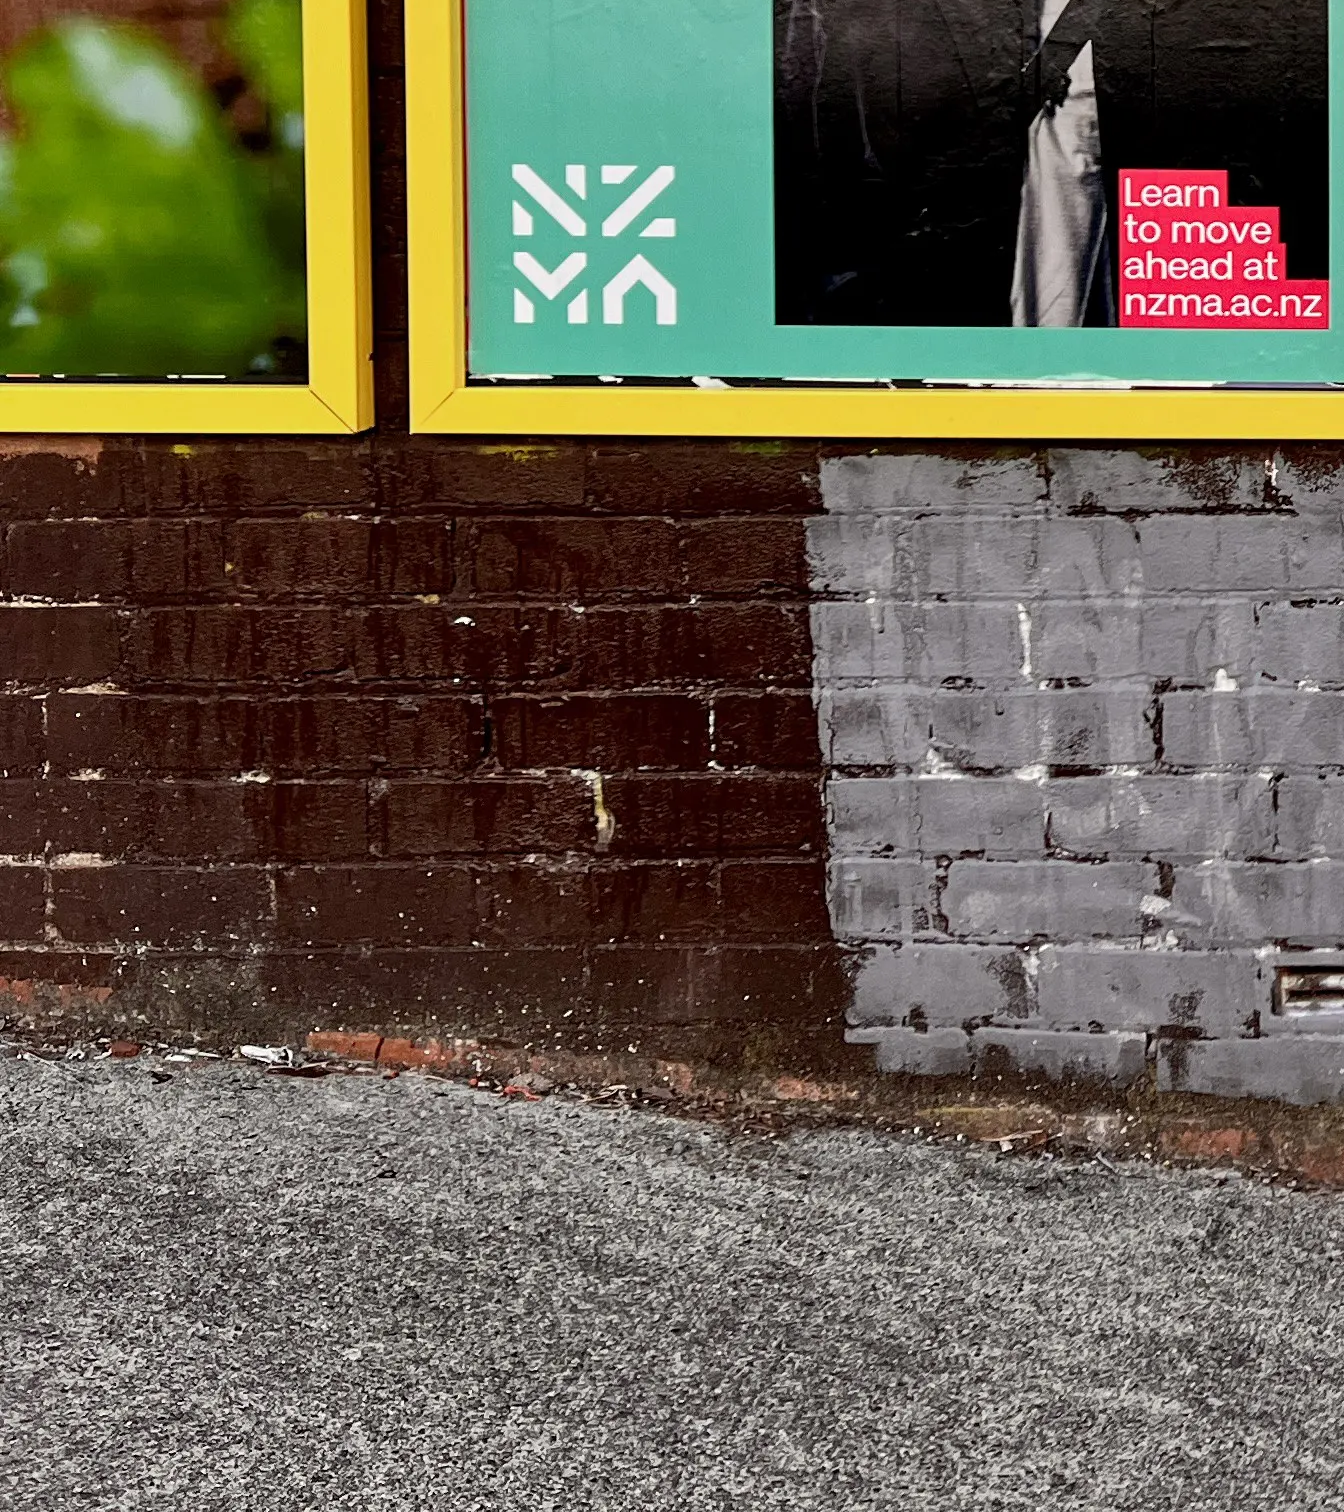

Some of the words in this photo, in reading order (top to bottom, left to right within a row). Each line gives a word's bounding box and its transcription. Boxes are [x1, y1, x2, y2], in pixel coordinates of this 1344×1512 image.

[1124, 177, 1220, 207] Learn
[1124, 213, 1162, 244] to
[1171, 221, 1272, 244] move
[1124, 250, 1233, 281] ahead
[1243, 251, 1278, 281] at
[1124, 292, 1322, 317] nzma.ac.nz
